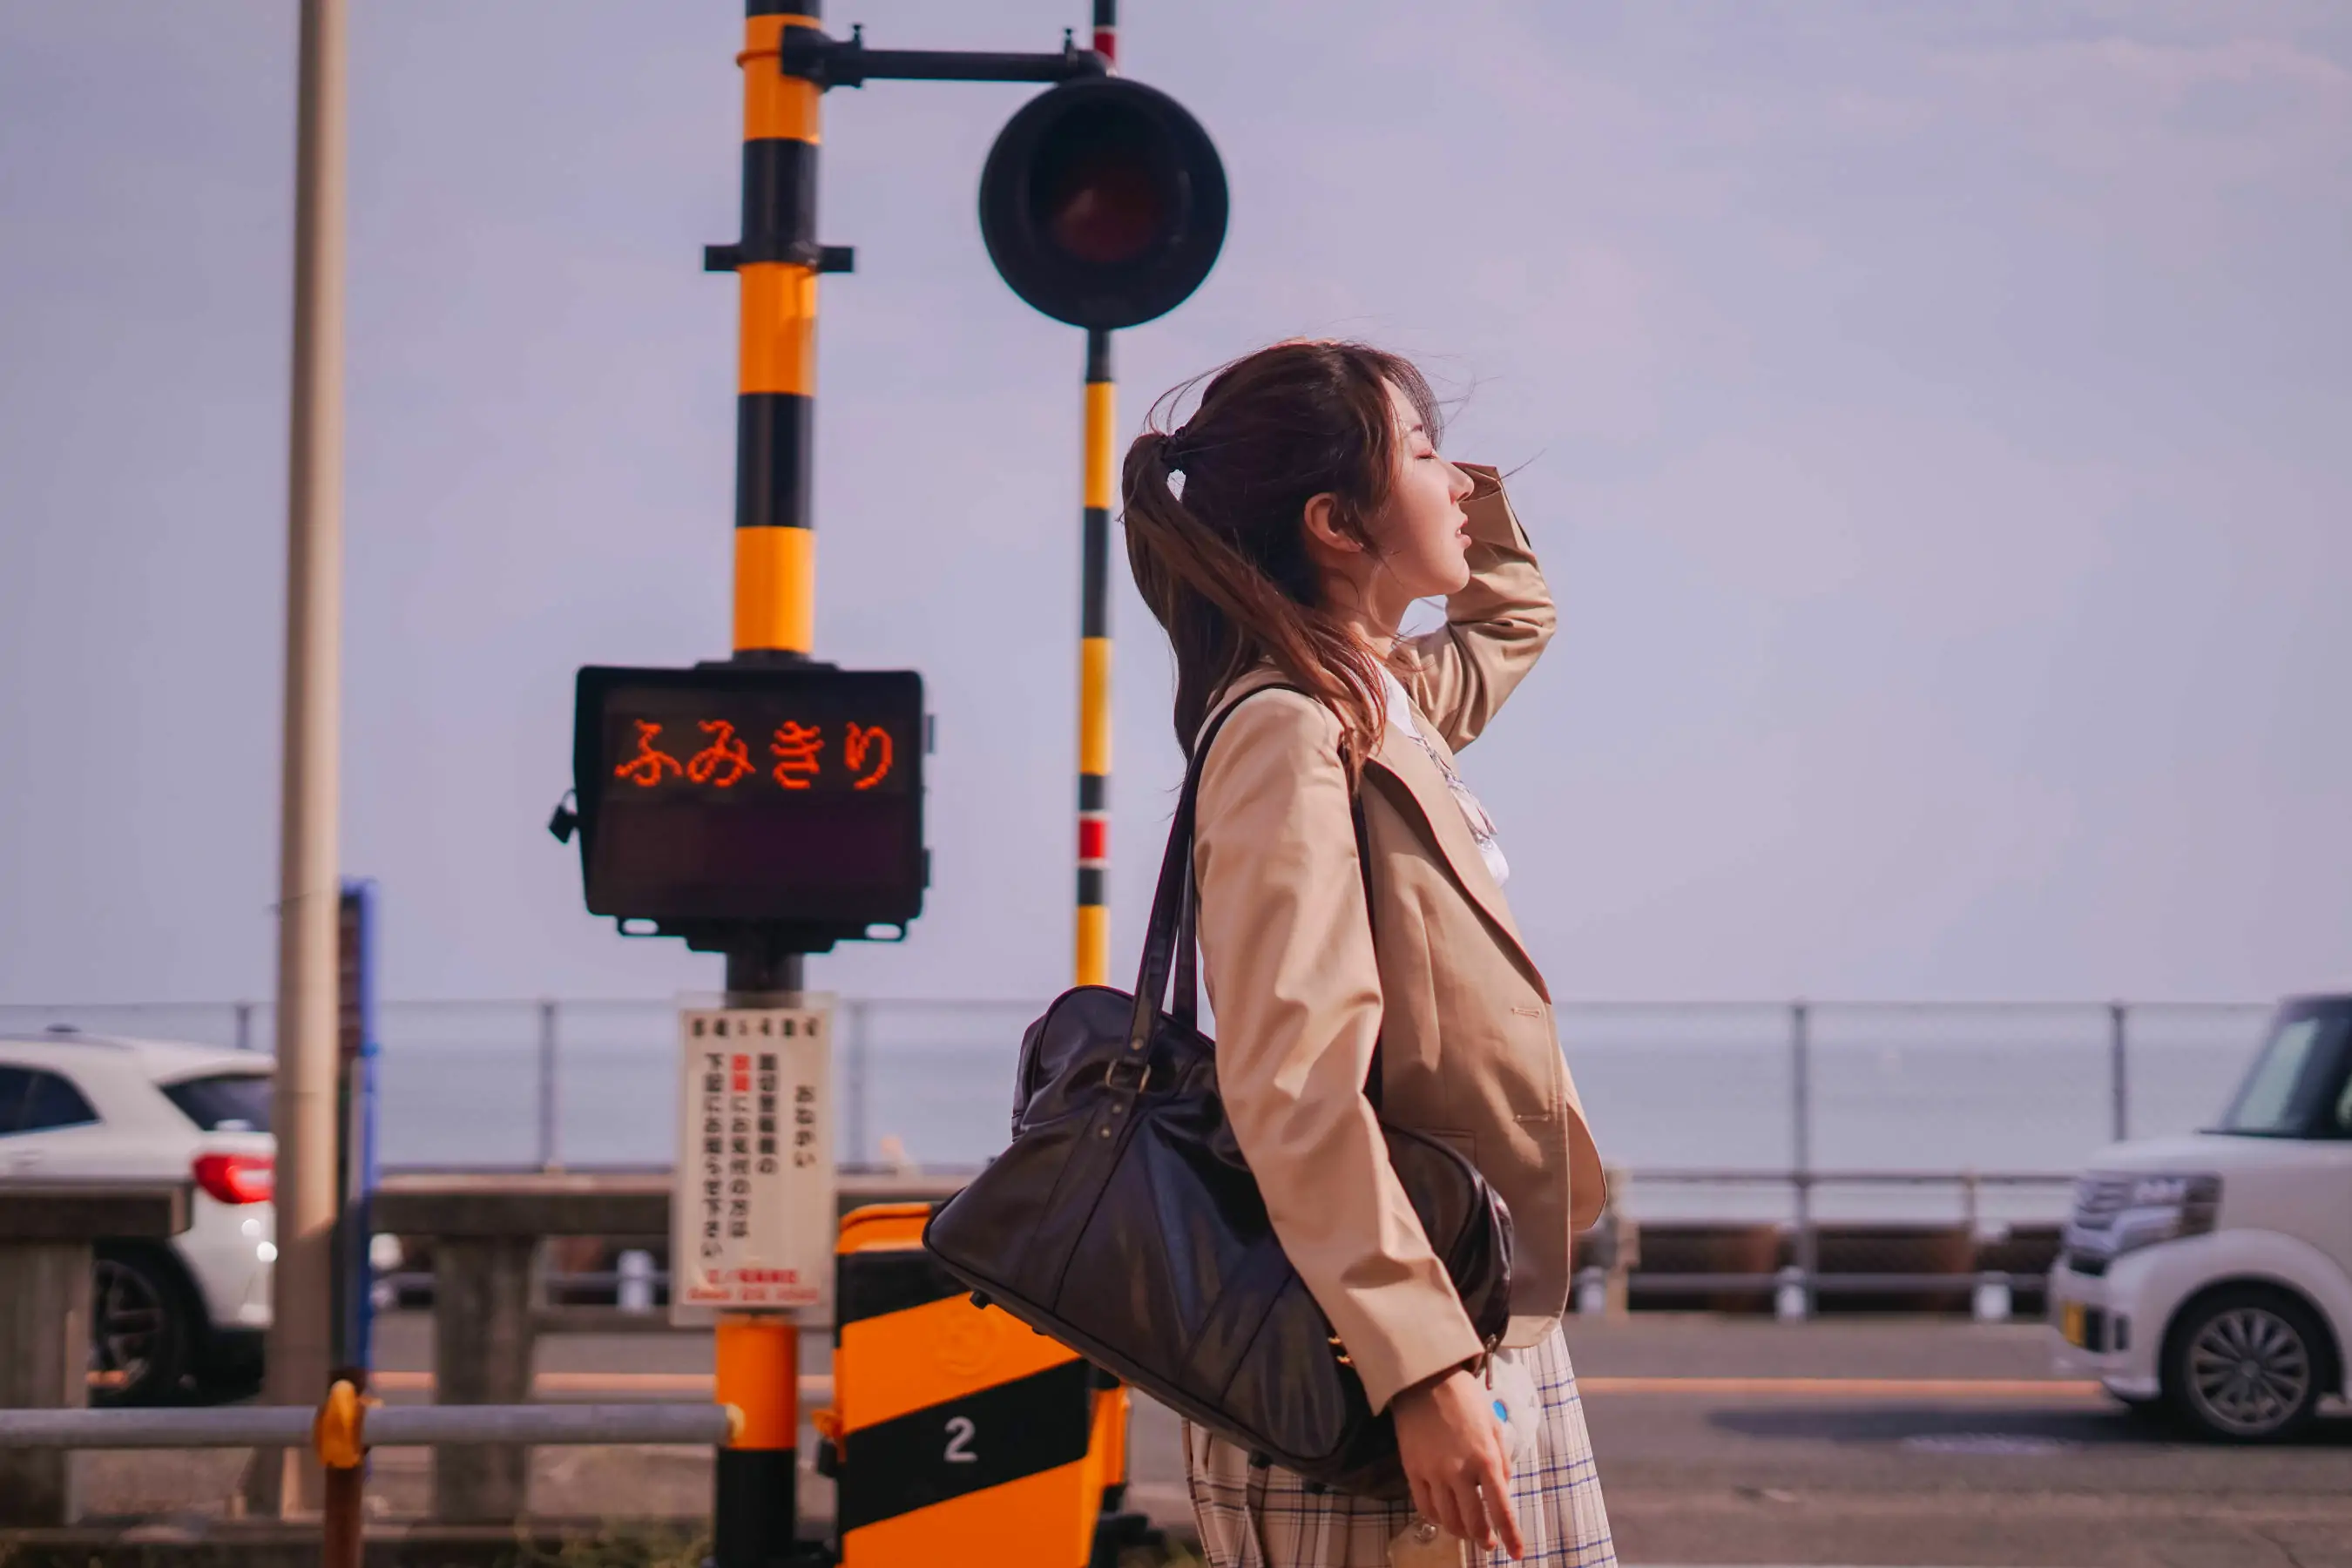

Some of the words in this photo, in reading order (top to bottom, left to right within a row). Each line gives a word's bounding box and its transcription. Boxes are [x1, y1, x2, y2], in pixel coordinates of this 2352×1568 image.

[614, 719, 893, 790] ふみきり
[943, 1416, 978, 1463] 2
